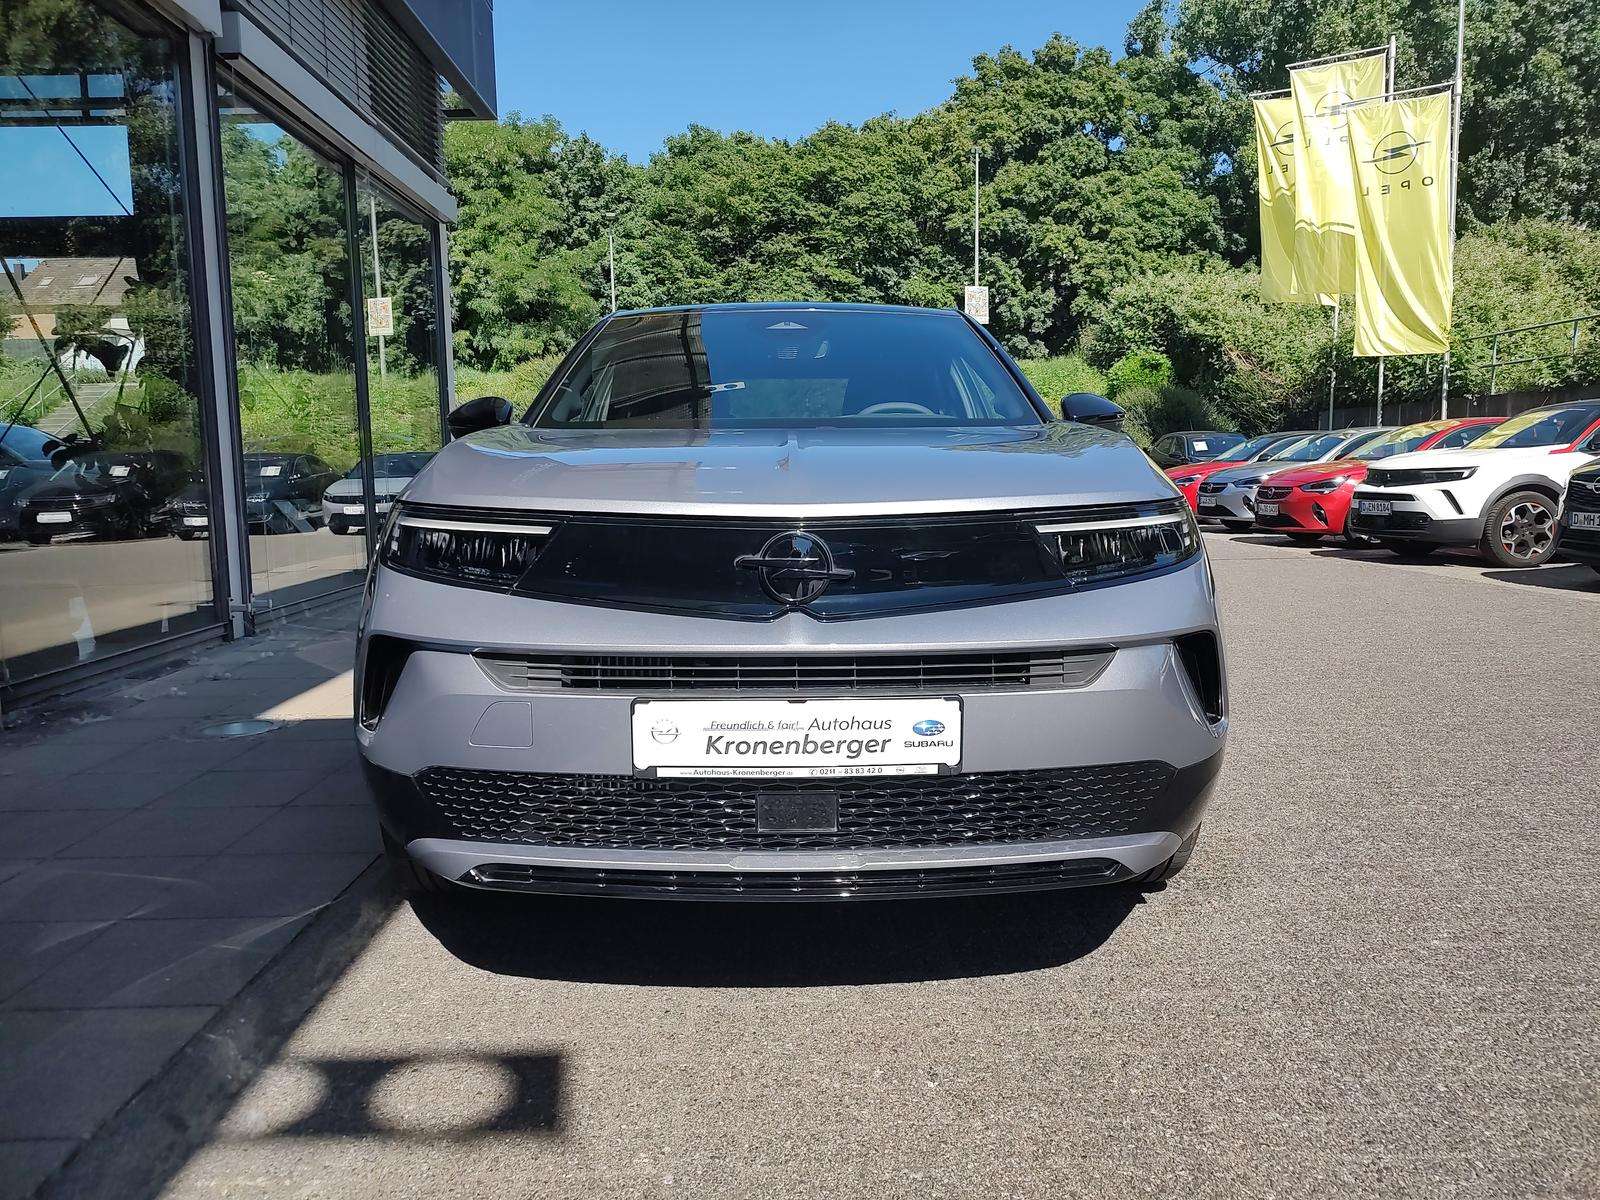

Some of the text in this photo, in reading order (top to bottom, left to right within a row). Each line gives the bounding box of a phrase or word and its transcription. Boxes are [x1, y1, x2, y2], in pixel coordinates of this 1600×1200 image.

[710, 720, 765, 731] Freundlich
[767, 720, 775, 730] &
[807, 716, 892, 731] Autohaus
[705, 734, 892, 759] Kronenberger
[903, 740, 954, 748] SUBARU
